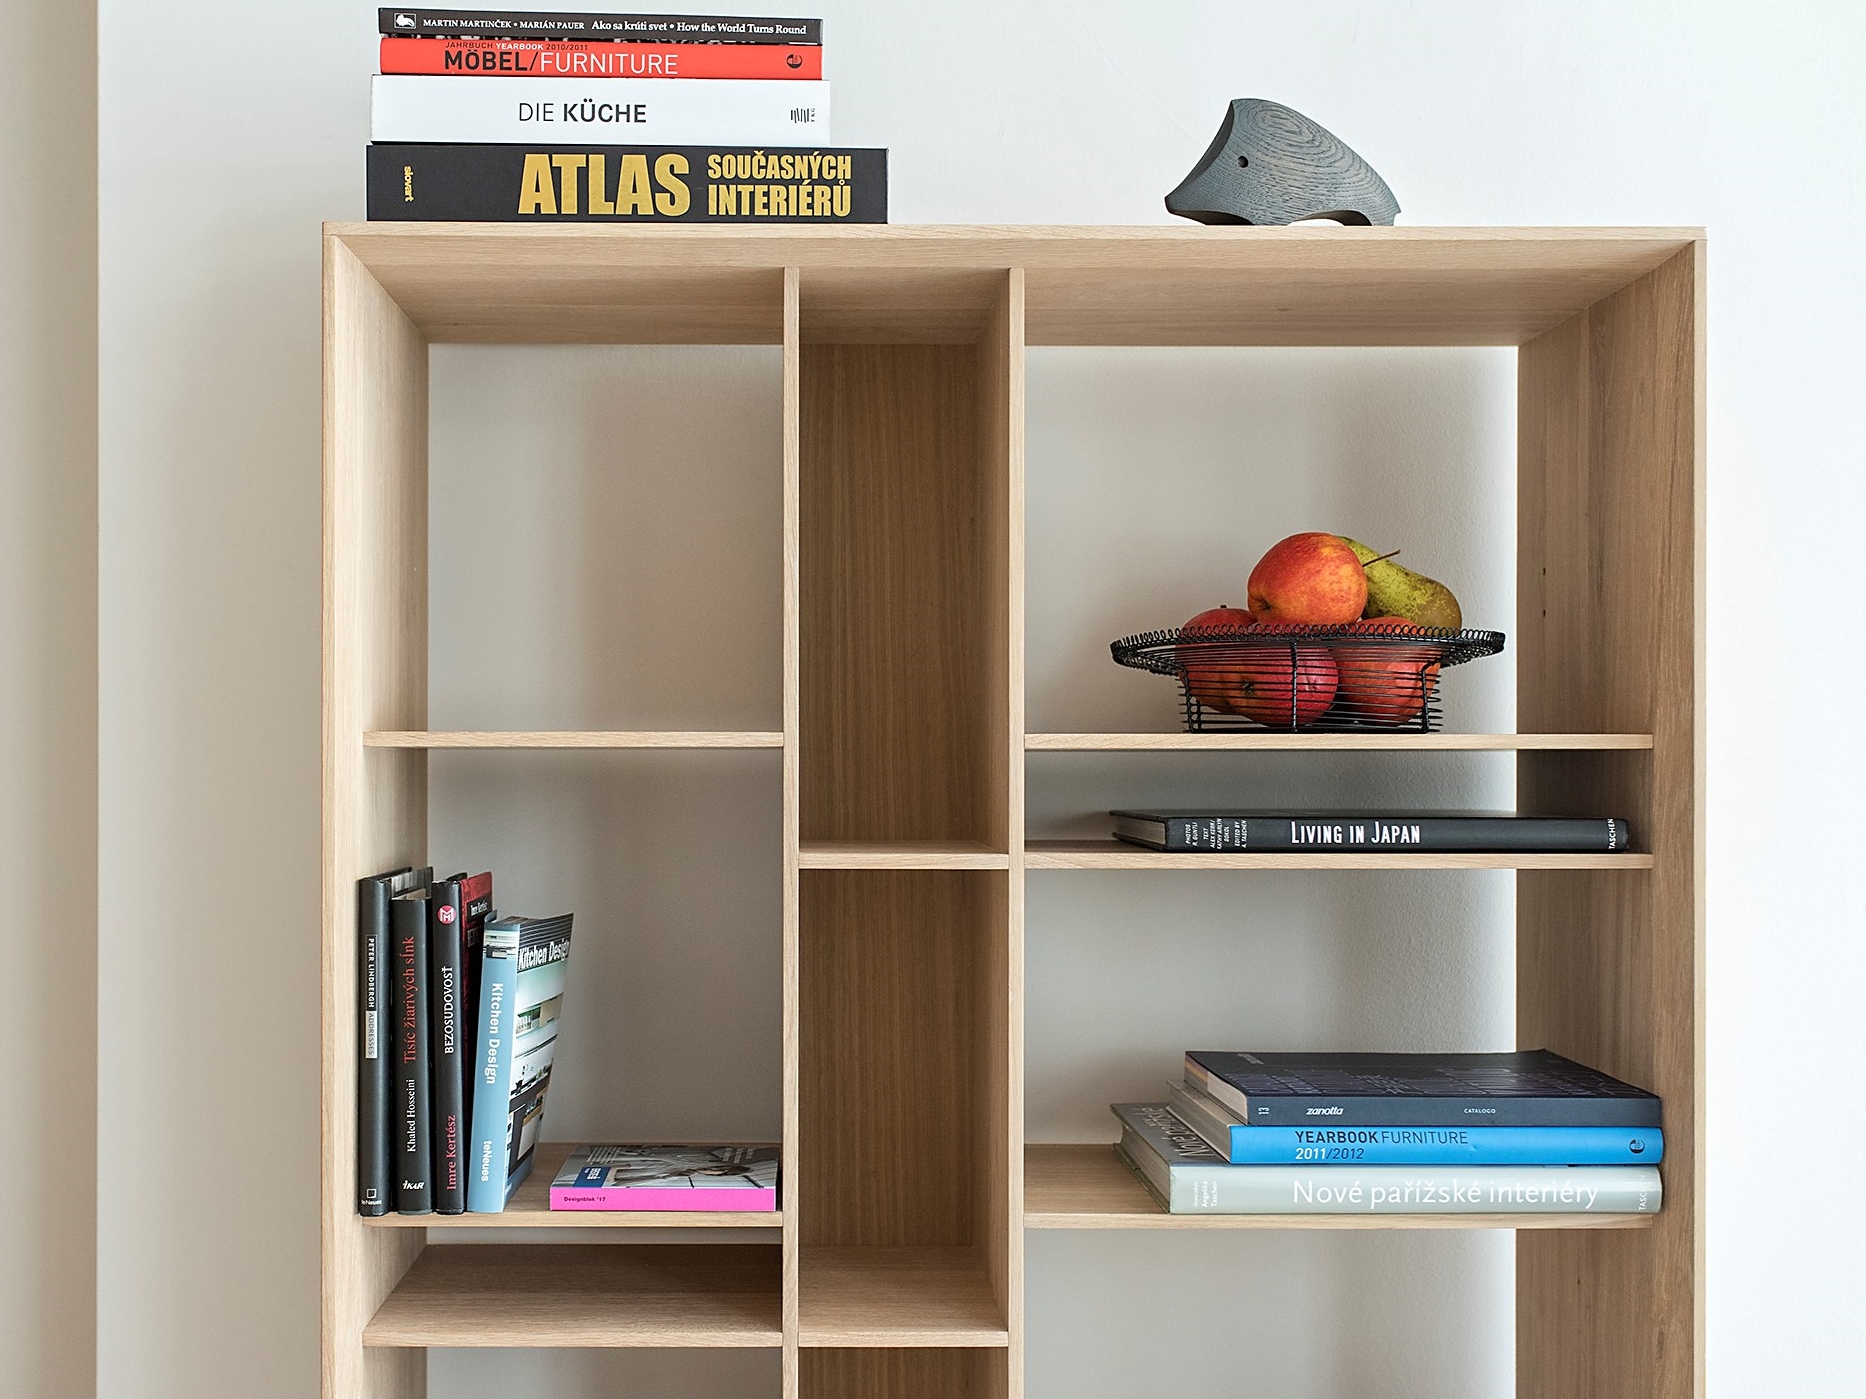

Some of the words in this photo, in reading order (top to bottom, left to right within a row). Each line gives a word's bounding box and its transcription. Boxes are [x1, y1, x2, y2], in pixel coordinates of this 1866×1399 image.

[423, 19, 459, 27] MARTIN
[460, 18, 512, 28] MARTINČEK
[520, 20, 555, 29] MARIÁN
[557, 21, 585, 30] PAUER
[592, 21, 612, 30] Ako
[624, 20, 647, 31] krúti
[648, 23, 668, 31] svet
[676, 22, 699, 32] How
[701, 23, 716, 32] the
[717, 23, 746, 33] World
[746, 24, 774, 34] Turns
[775, 25, 807, 35] Round
[546, 43, 588, 51] 2010/2011
[519, 102, 554, 122] DIE
[563, 98, 647, 123] KÜCHE
[707, 150, 852, 180] SOUČASNÝCH
[404, 165, 414, 202] slovart
[518, 153, 691, 216] ATLAS
[708, 179, 851, 217] INTERIÉRŮ
[1607, 818, 1617, 849] TASCHEN
[518, 944, 547, 970] Kitchen
[441, 965, 453, 1054] BEZOSUDOVOSŤ
[490, 983, 504, 1034] Kitchen
[403, 1032, 416, 1064] Tisíc
[485, 1039, 500, 1084] Design
[406, 1078, 416, 1121] Hosseini
[1258, 1107, 1269, 1115] 13
[1306, 1106, 1343, 1116] zanotta
[406, 1122, 416, 1153] Khaled
[446, 1115, 457, 1158] Kertész
[481, 1140, 493, 1182] teNeues
[1295, 1147, 1365, 1160] 2011/2012
[446, 1160, 457, 1190] Imre
[1293, 1180, 1363, 1204] Nové
[1370, 1179, 1482, 1209] pařížské
[1489, 1180, 1599, 1209] interiéry
